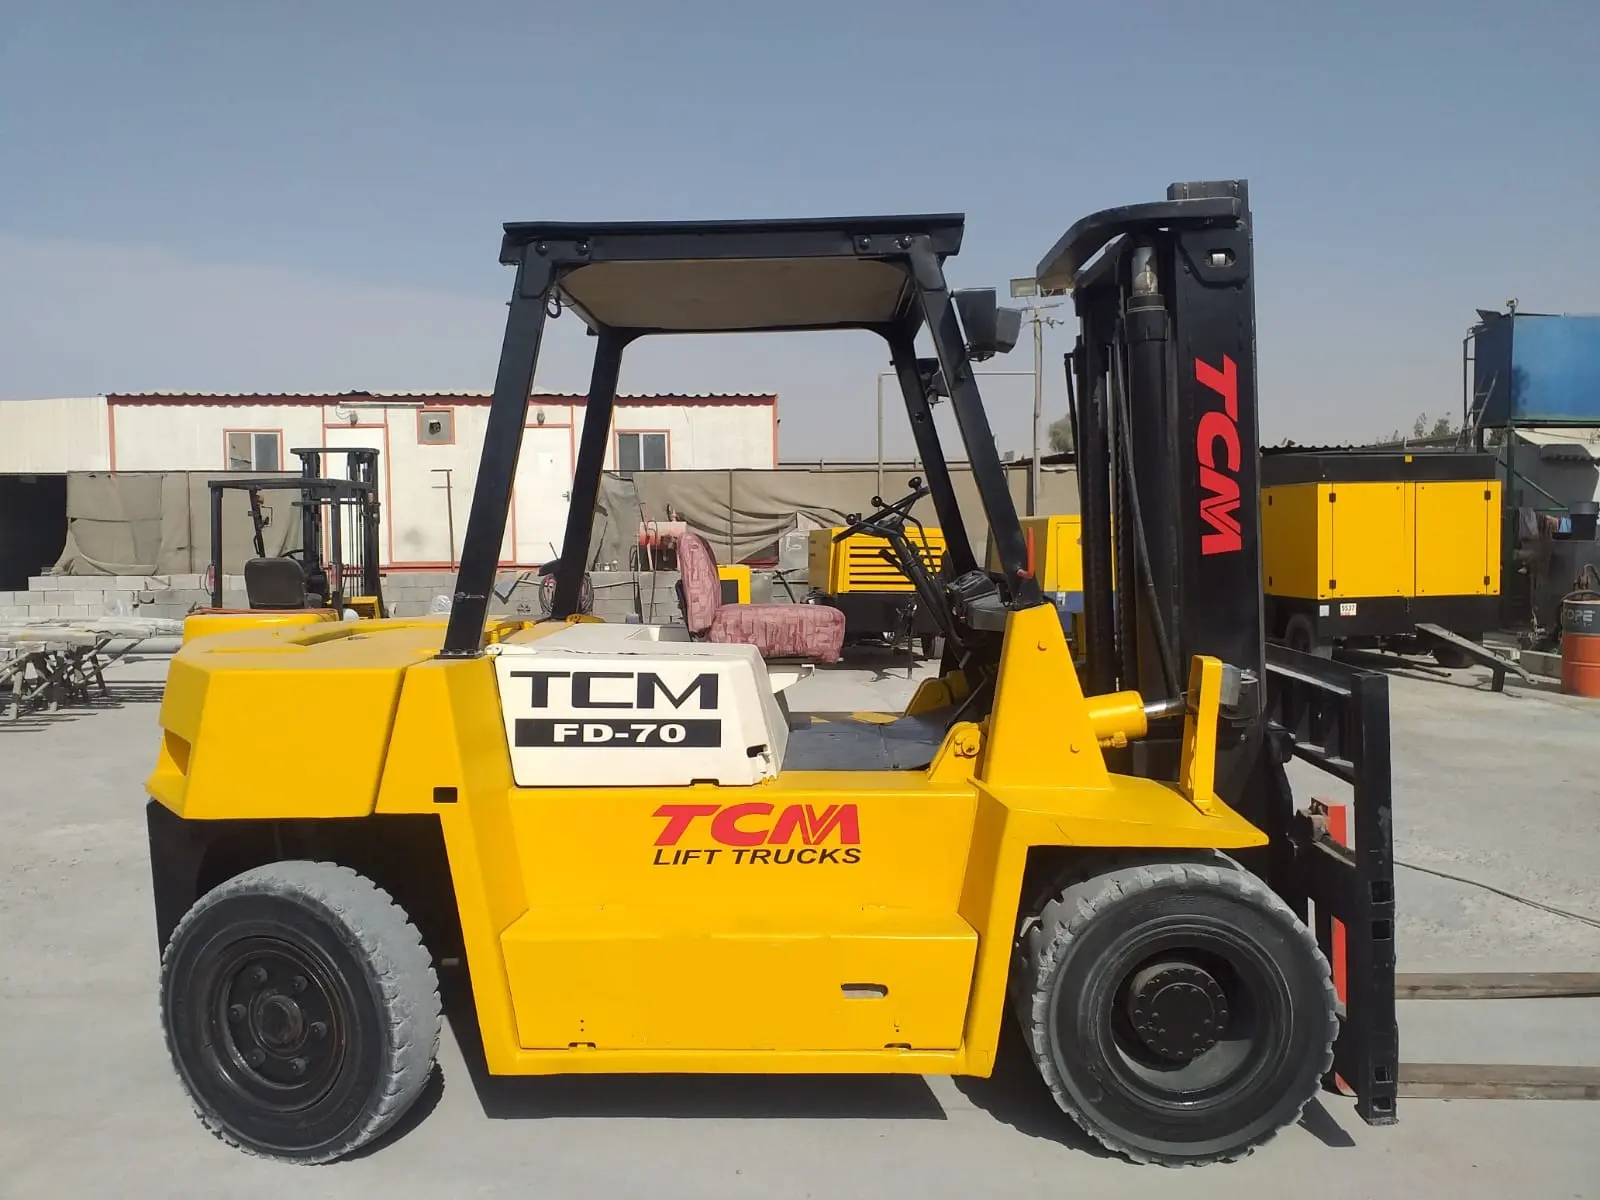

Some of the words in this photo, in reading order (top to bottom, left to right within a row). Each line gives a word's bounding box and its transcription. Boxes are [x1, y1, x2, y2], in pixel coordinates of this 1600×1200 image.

[1195, 354, 1242, 555] TCM
[510, 671, 718, 709] TCM
[553, 723, 687, 743] FD-70
[652, 803, 860, 846] TCM
[653, 849, 722, 865] LIFT
[733, 848, 861, 865] TRUCKS
